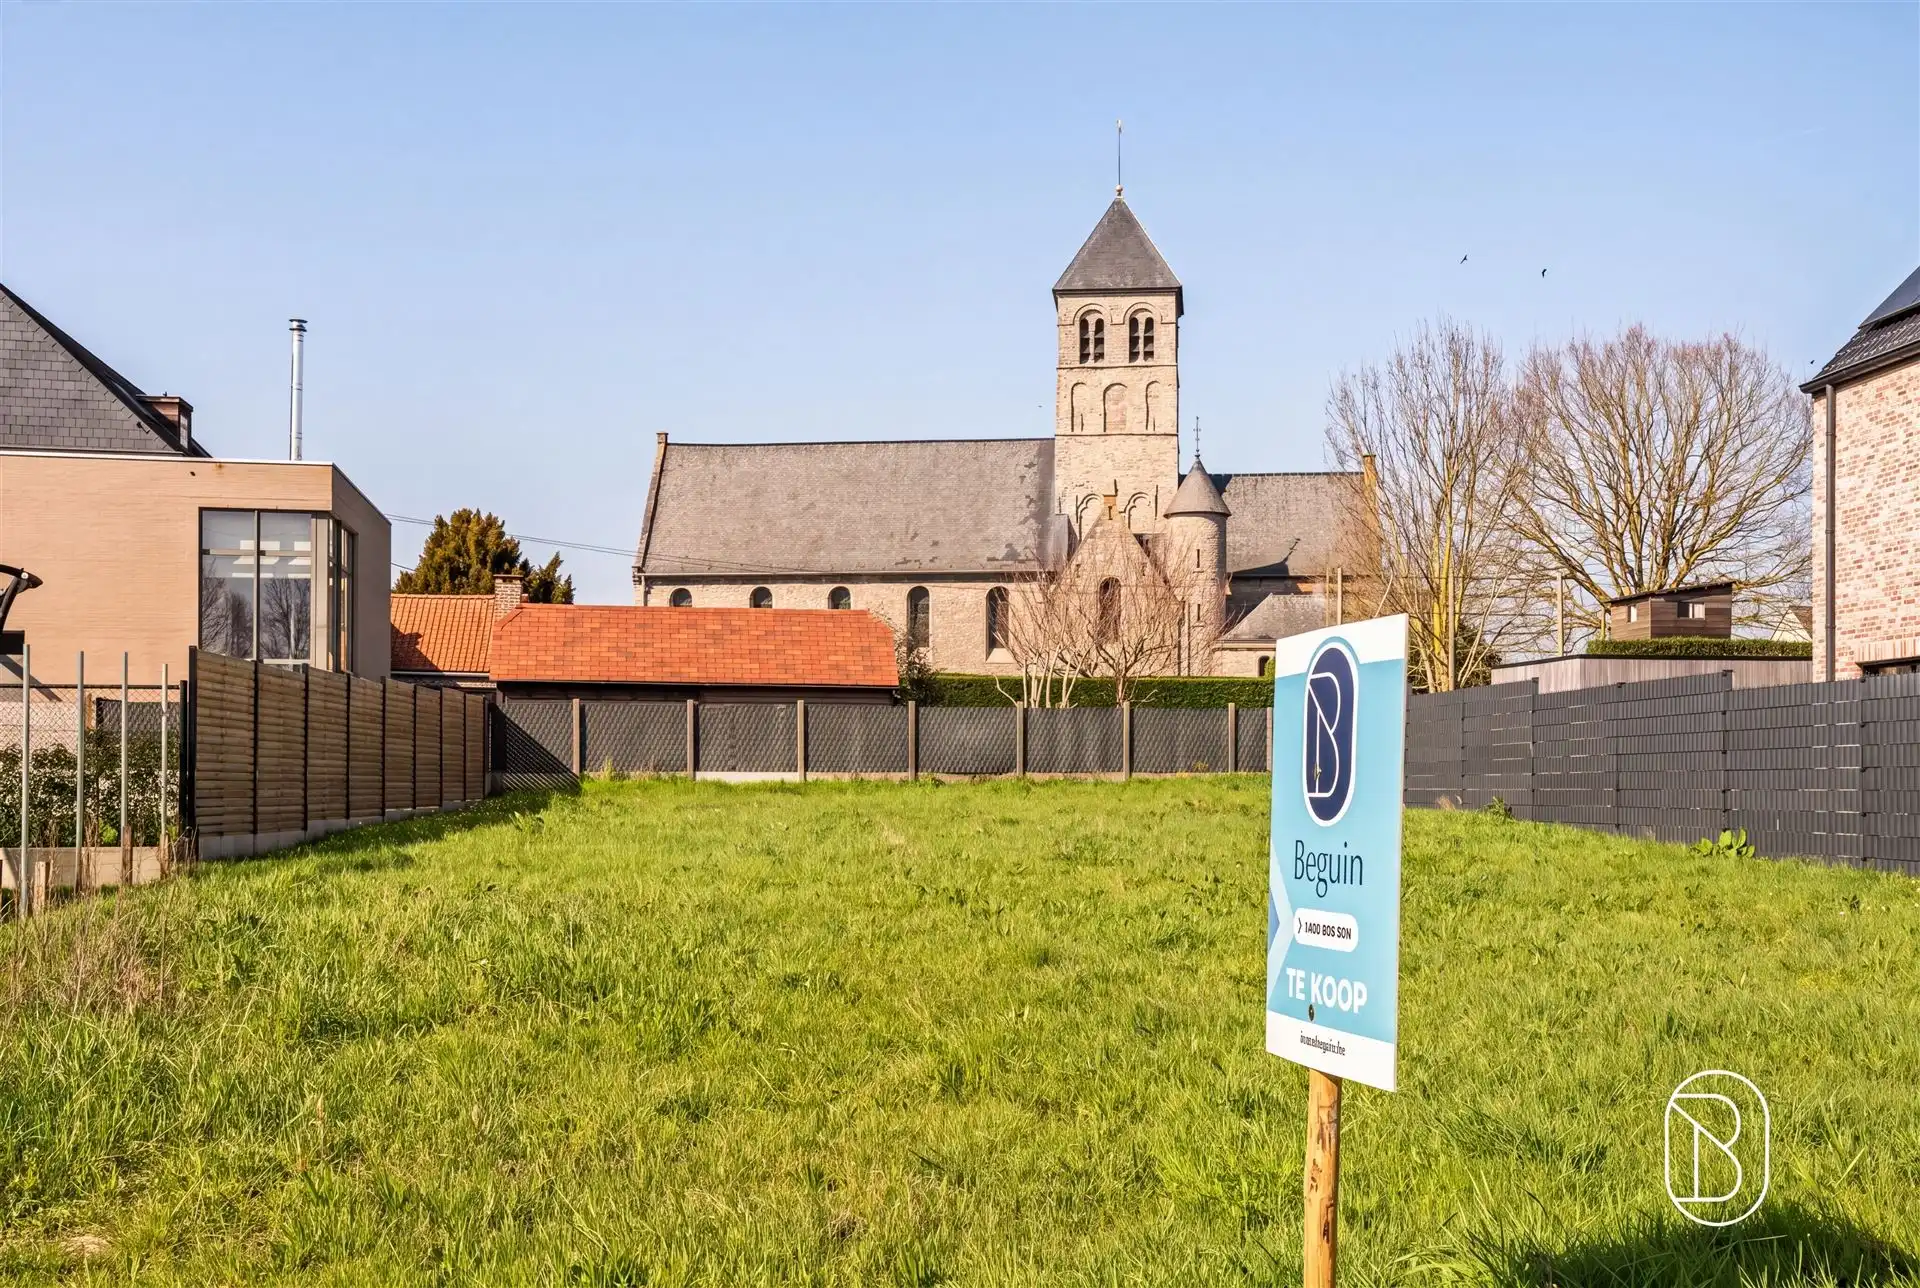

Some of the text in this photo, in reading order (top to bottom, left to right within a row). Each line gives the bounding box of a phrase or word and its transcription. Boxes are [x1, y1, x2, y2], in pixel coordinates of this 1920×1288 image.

[1294, 839, 1364, 898] Beguin
[1336, 926, 1352, 940] SON
[1286, 967, 1368, 1014] TE KOOP
